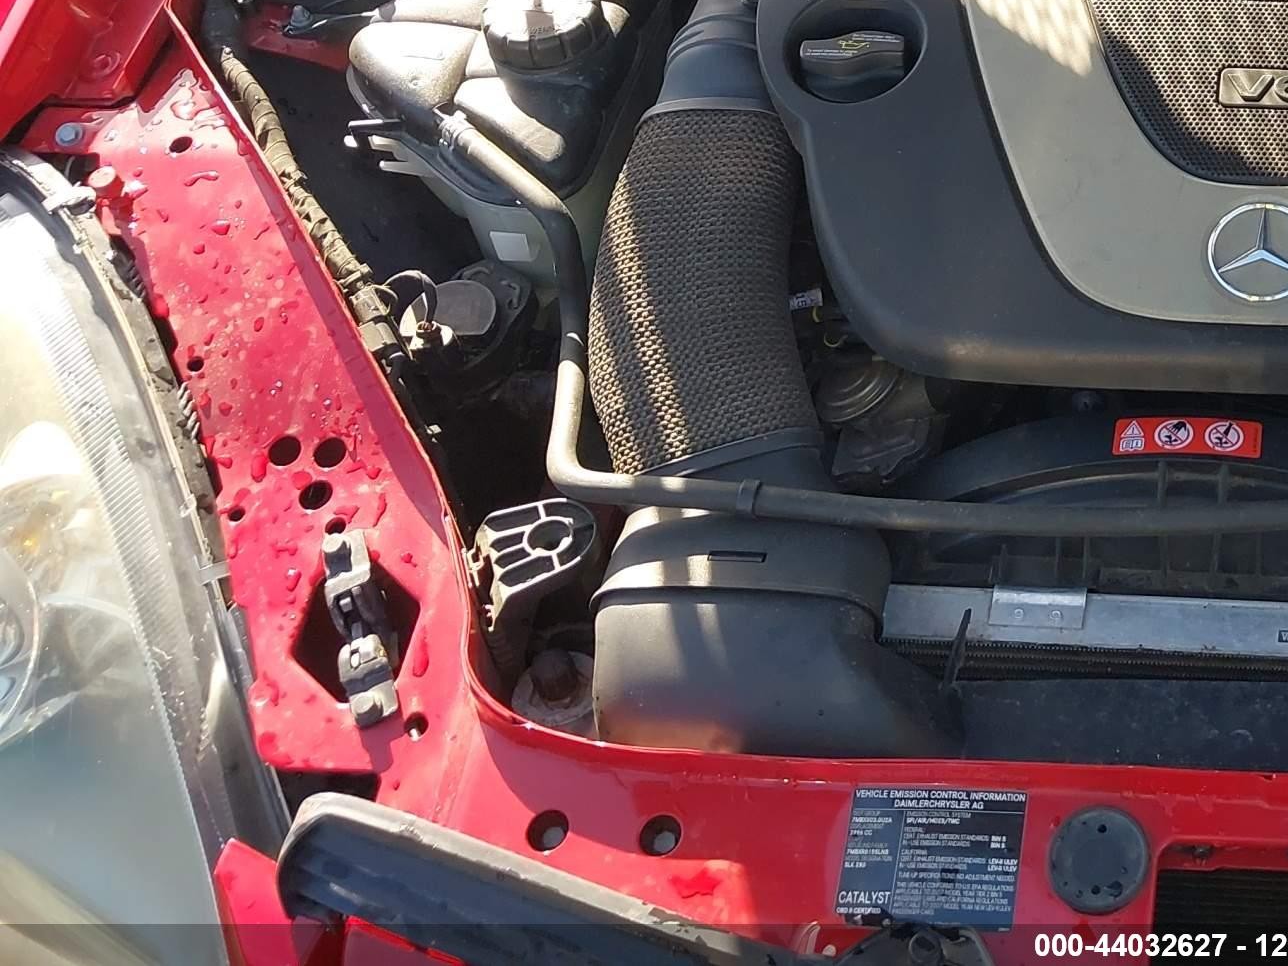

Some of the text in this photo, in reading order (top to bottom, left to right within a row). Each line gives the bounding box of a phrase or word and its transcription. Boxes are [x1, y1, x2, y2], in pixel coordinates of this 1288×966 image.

[855, 789, 1026, 802] VEHICLE EMISSION CONTROL INFORMATION
[894, 799, 984, 809] DAIMLERCHRYSLER AG
[838, 890, 891, 904] CATALYST
